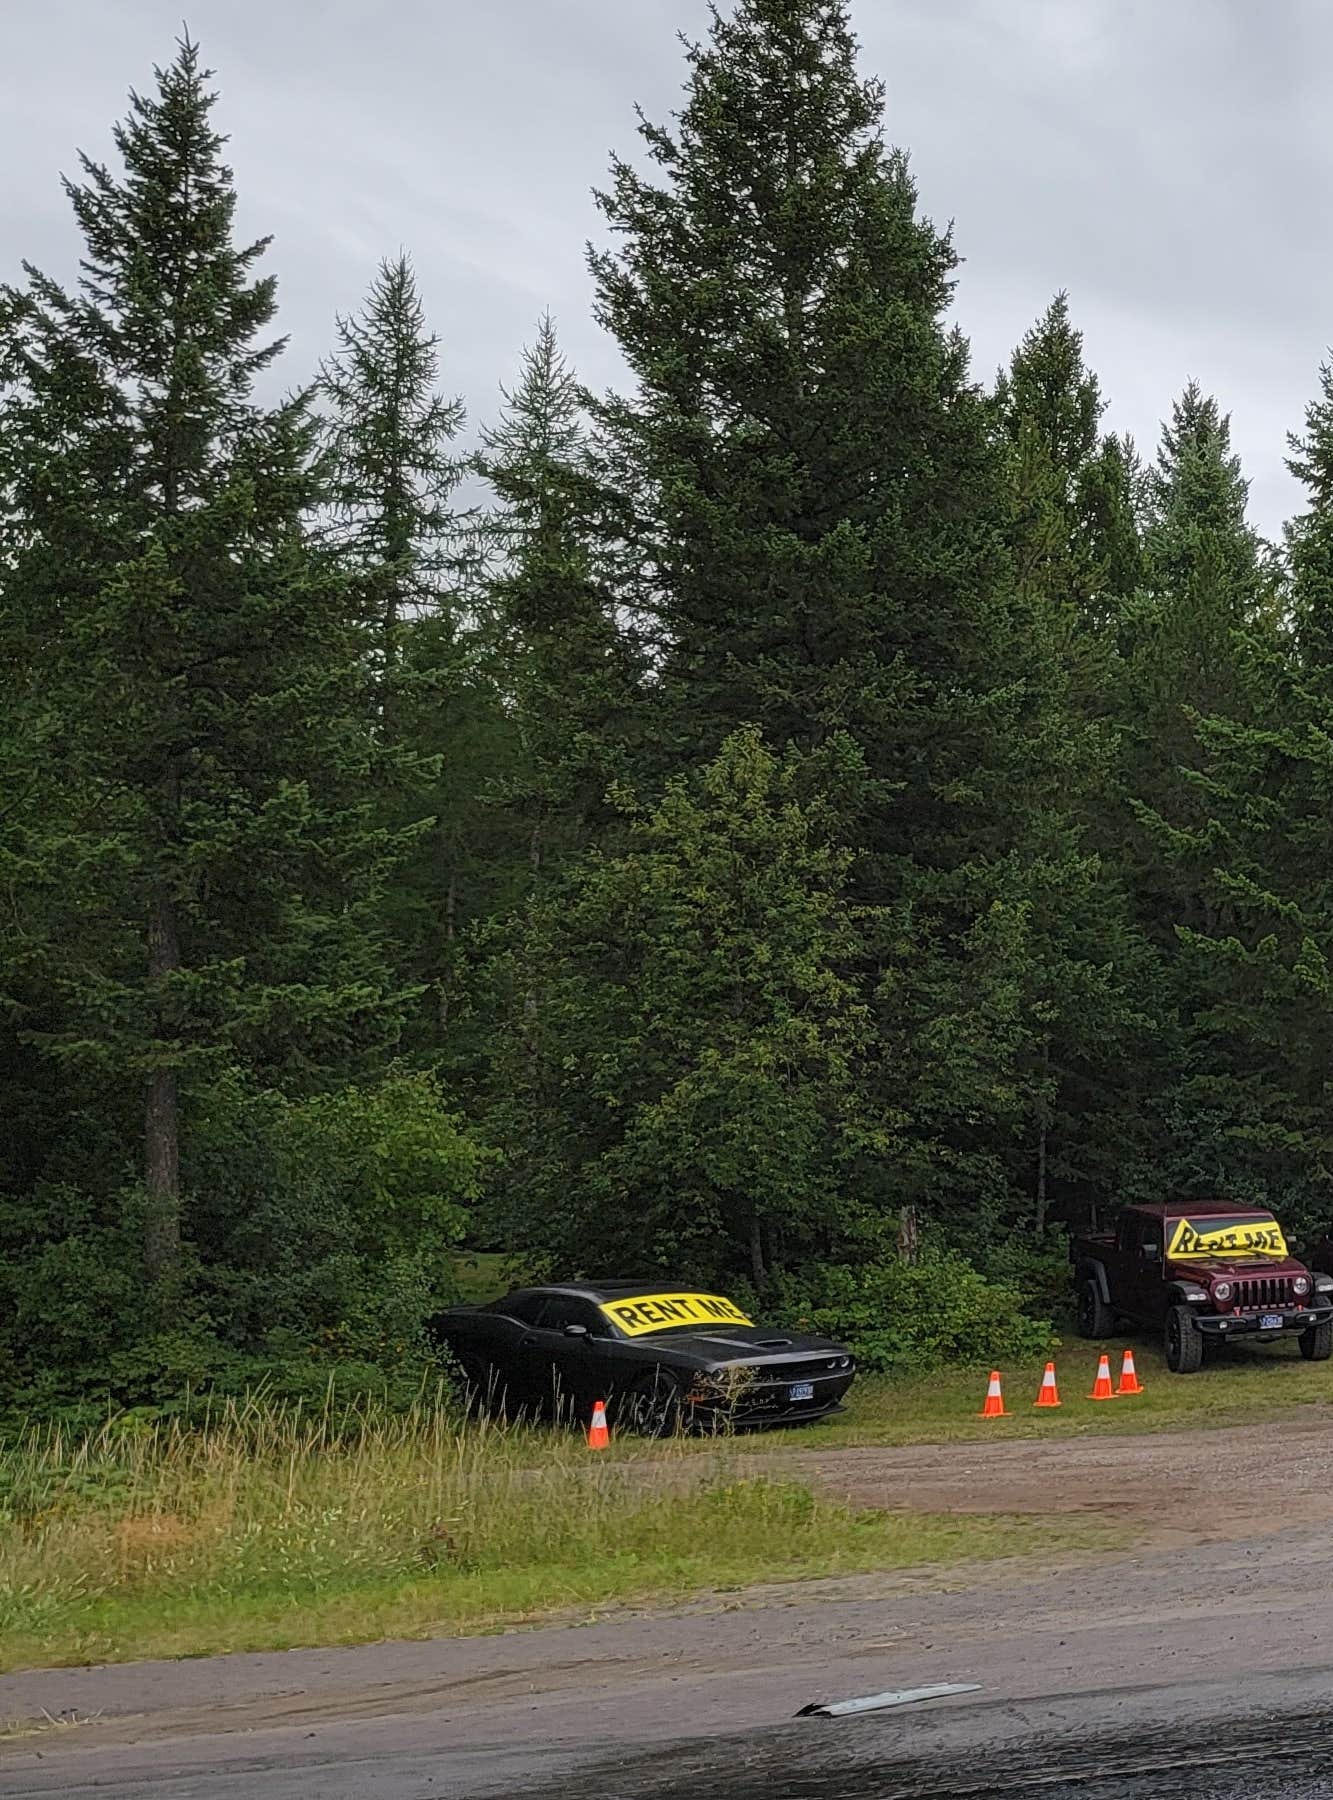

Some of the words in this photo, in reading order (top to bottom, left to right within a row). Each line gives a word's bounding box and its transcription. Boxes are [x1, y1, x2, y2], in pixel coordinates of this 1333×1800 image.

[1243, 1229, 1283, 1250] ME
[612, 1299, 699, 1329] RENT
[693, 1299, 749, 1320] ME
